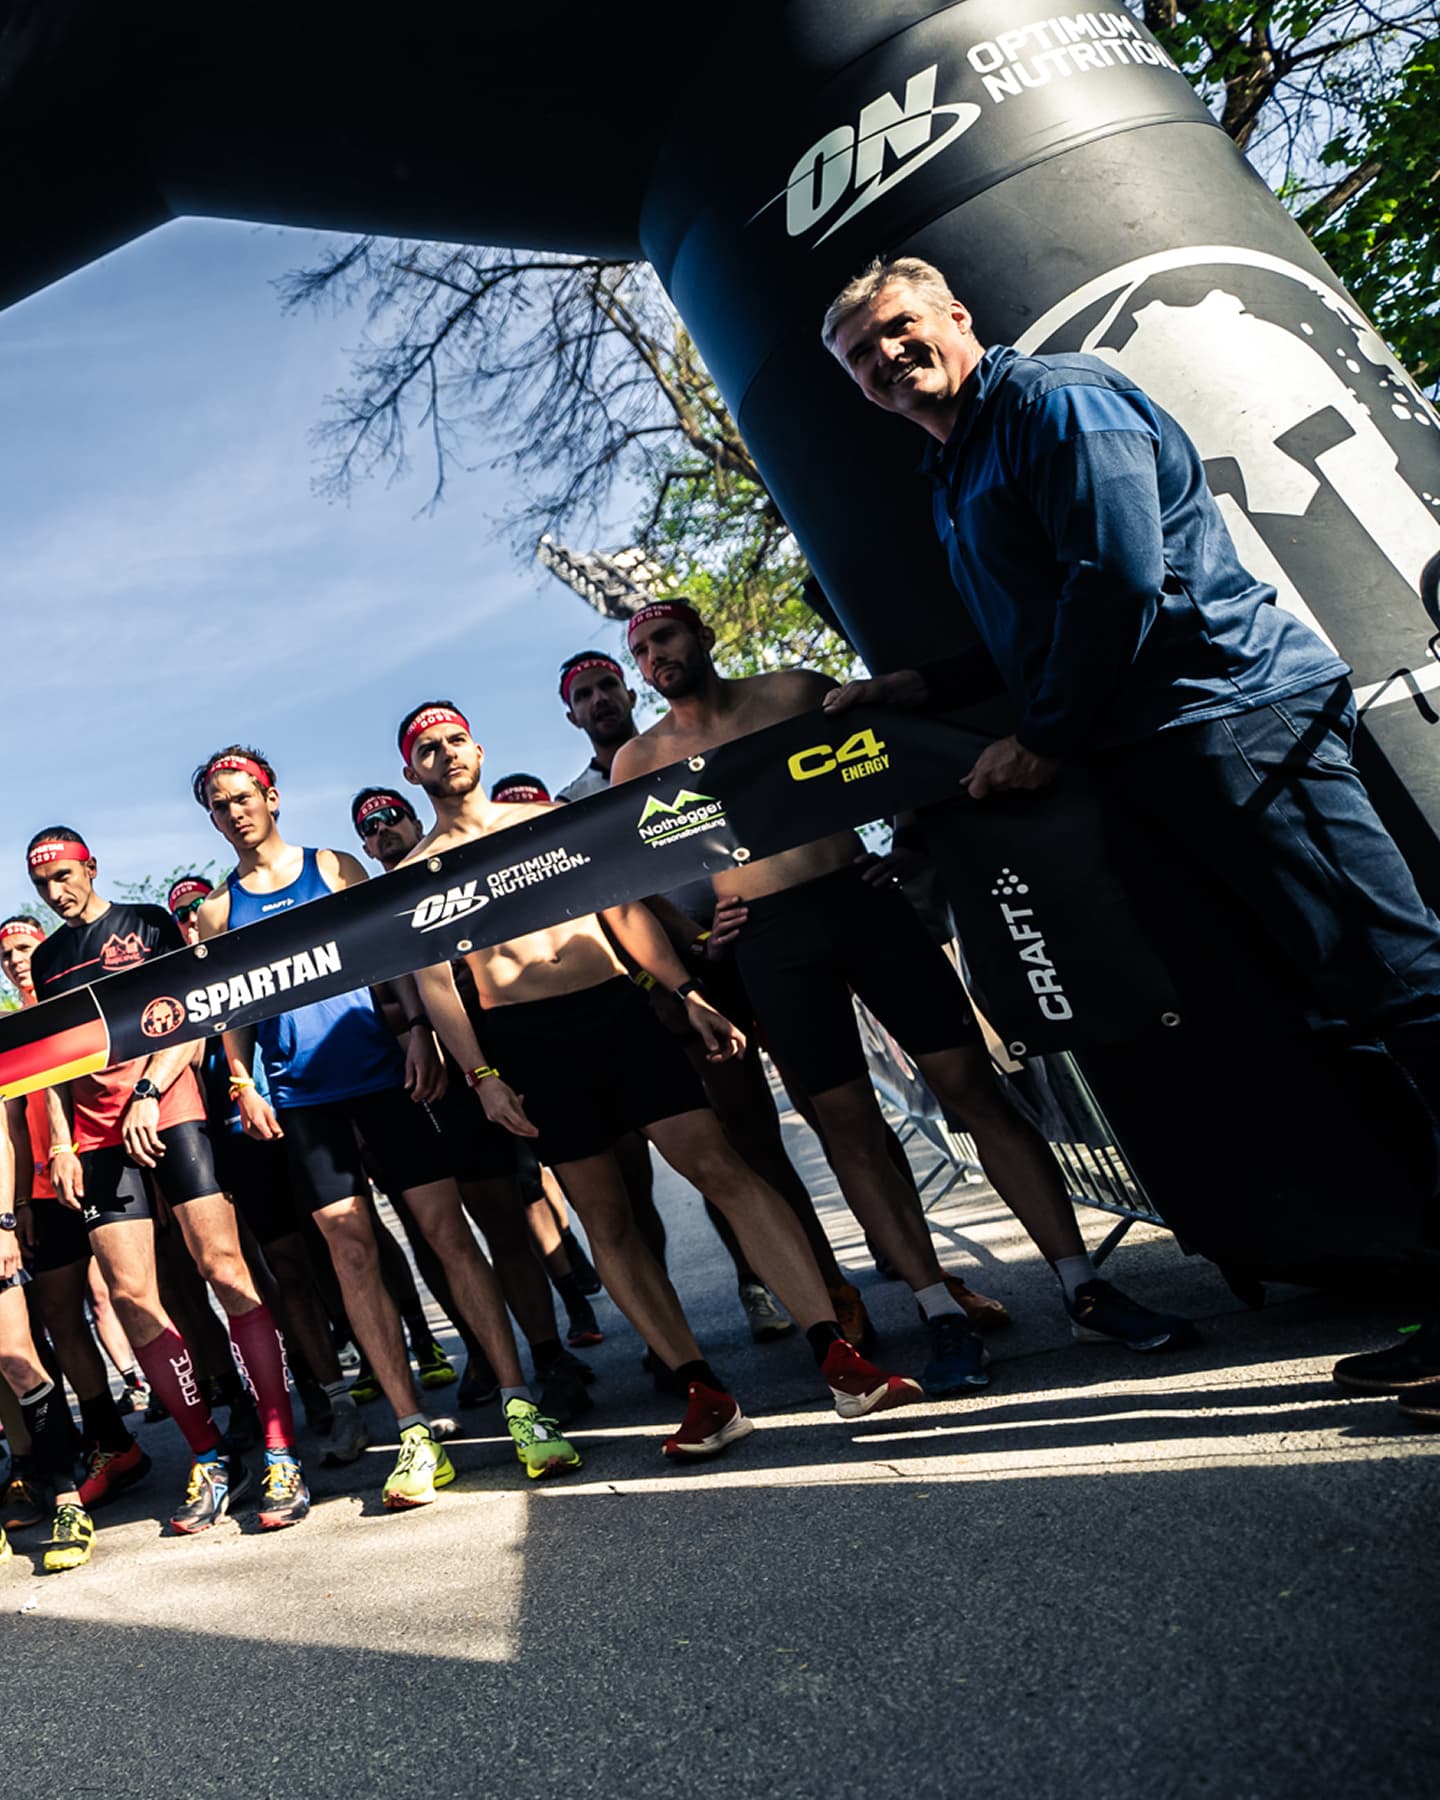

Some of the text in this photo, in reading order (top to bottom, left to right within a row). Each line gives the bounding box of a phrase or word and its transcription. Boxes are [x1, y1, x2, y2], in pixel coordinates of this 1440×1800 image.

[967, 12, 1142, 73] OPTIMUM
[778, 64, 962, 240] ON
[788, 728, 885, 780] C4
[841, 754, 889, 783] ENERGY
[639, 800, 723, 840] Nothegger
[486, 847, 568, 888] OPTIMUM
[405, 879, 483, 930] ON
[185, 940, 343, 1023] SPARTAN
[999, 903, 1073, 1020] CRAFT
